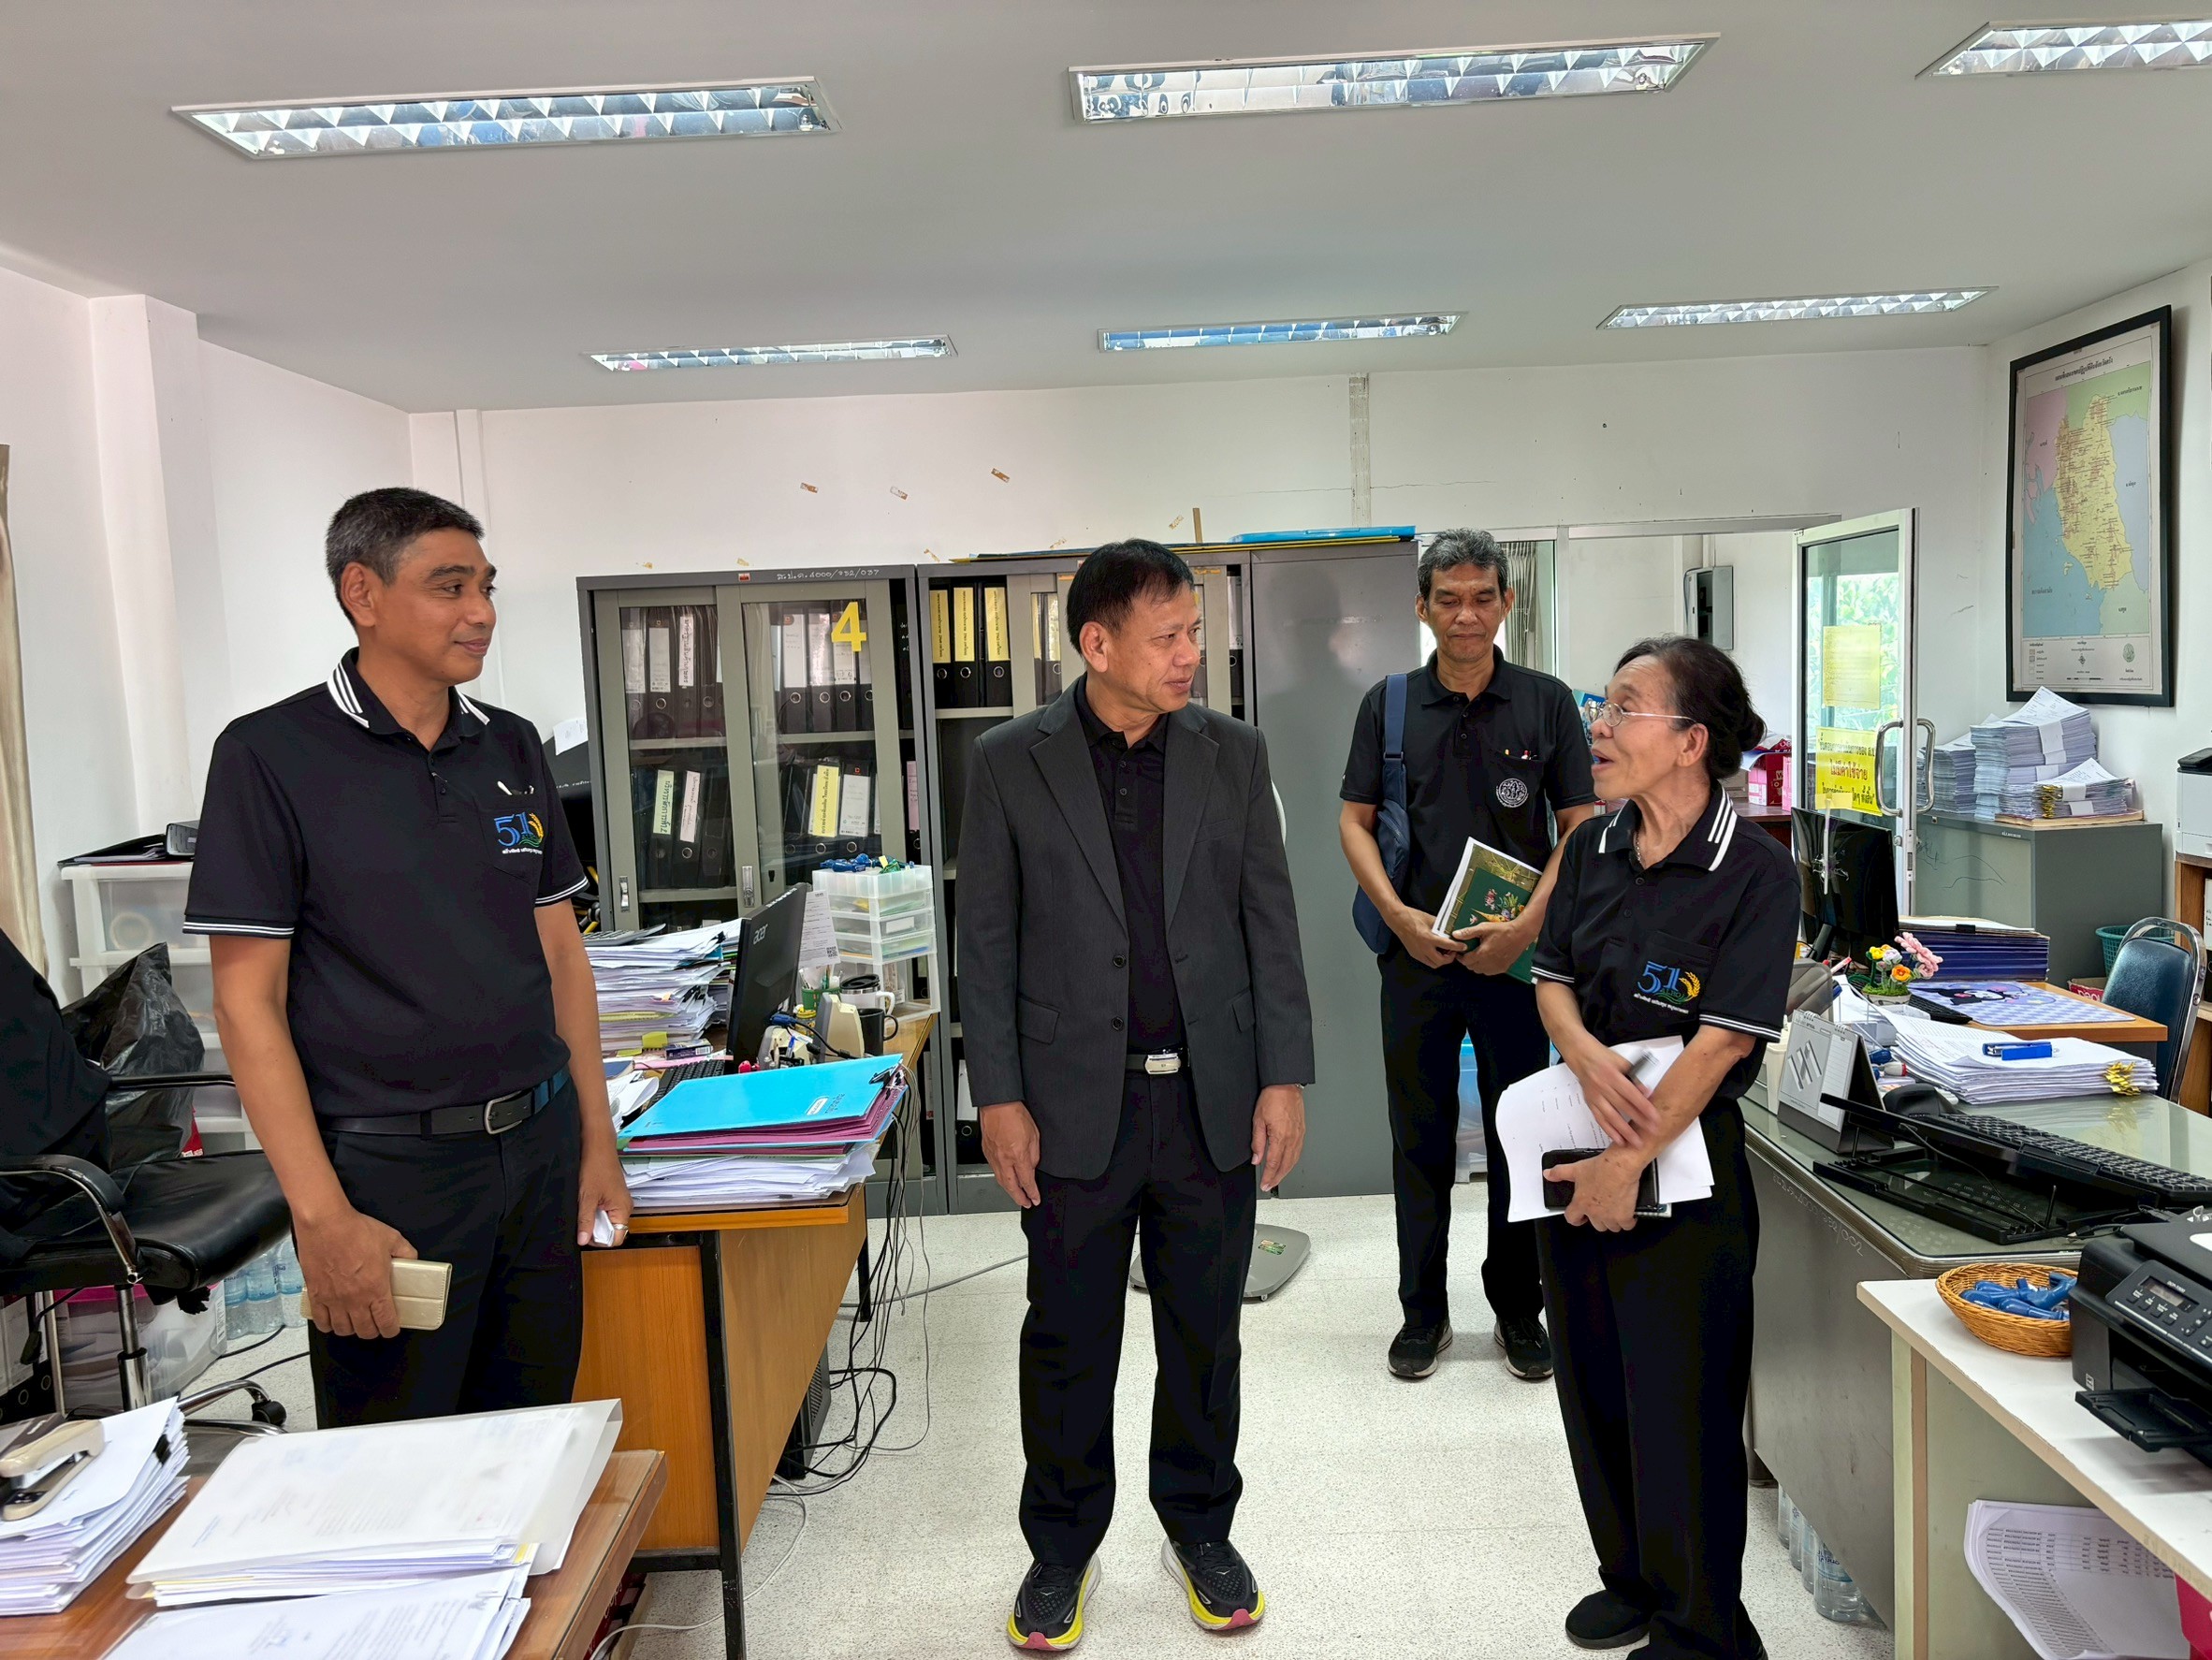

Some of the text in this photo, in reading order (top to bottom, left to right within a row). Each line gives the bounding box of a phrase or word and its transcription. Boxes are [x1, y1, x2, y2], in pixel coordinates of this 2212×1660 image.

[831, 602, 867, 652] 4
[1830, 759, 1868, 780] ไม่มีค่าใช้จ่าย
[494, 811, 533, 847] 51
[752, 924, 768, 945] acer
[1637, 961, 1680, 994] 51
